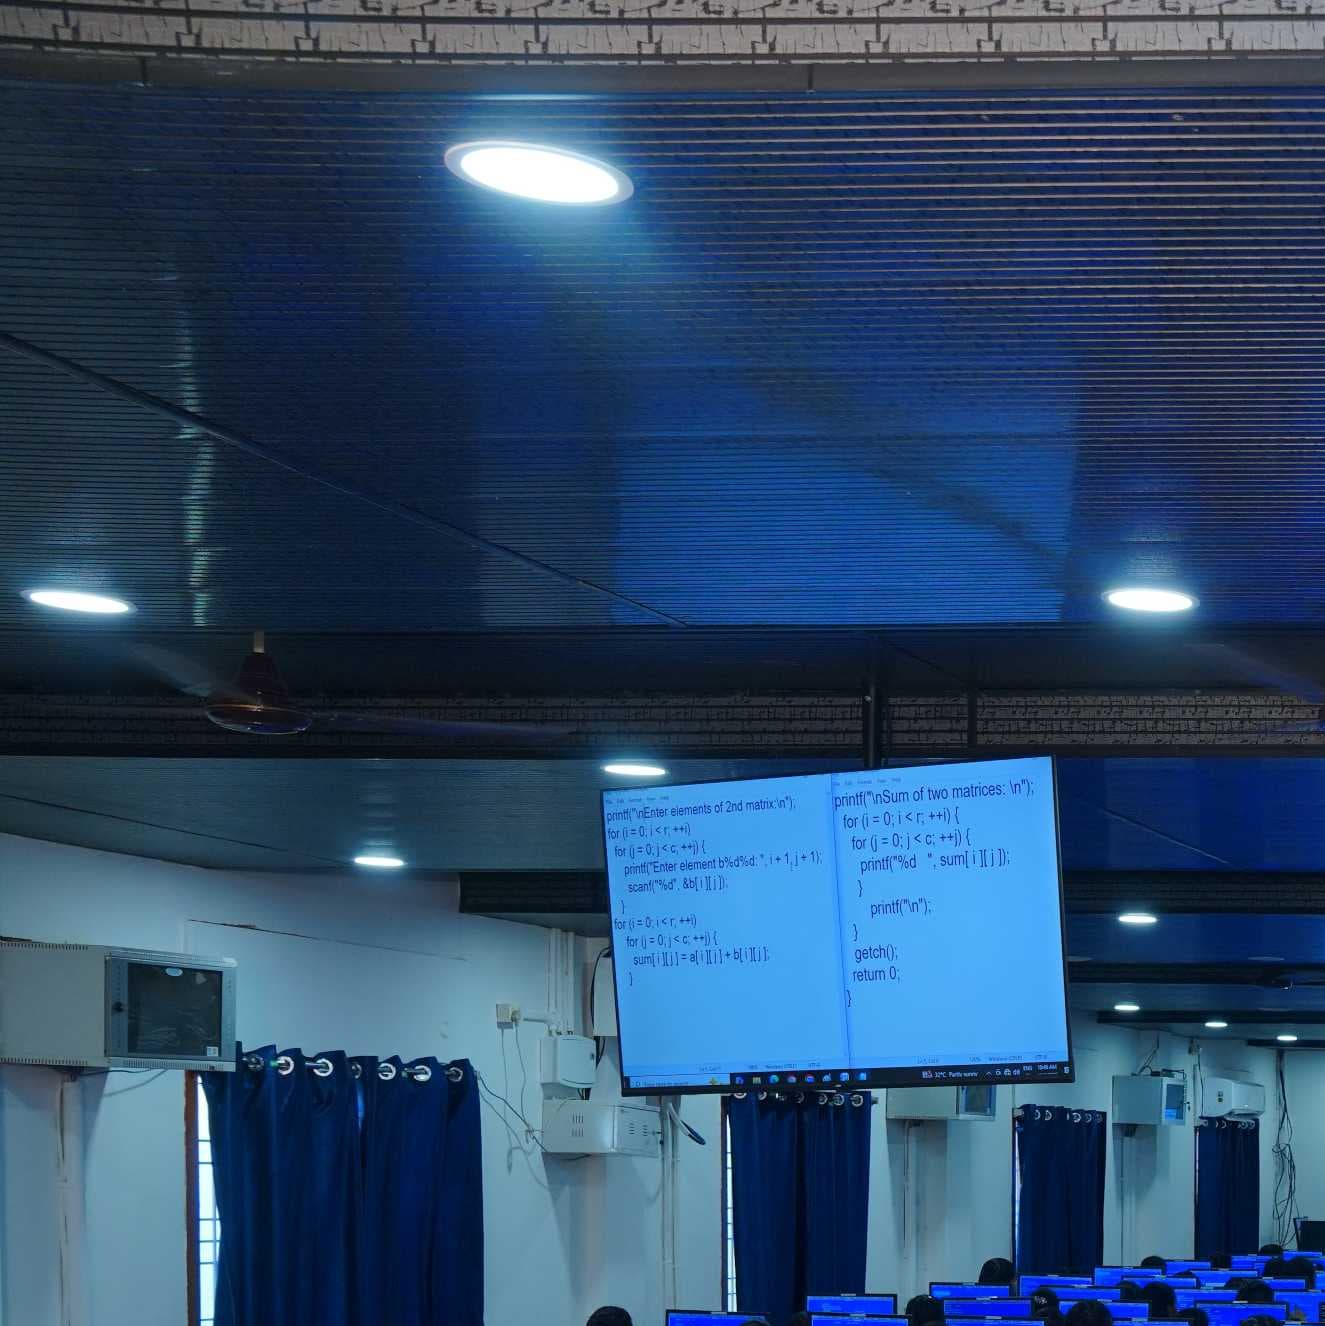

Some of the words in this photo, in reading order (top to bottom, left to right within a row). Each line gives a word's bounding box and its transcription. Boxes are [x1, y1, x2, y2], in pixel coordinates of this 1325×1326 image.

[913, 787, 925, 801] of
[927, 787, 949, 800] two
[952, 782, 1005, 798] matrices:
[670, 802, 711, 816] elements
[714, 801, 724, 814] of
[725, 800, 742, 813] 2nd
[680, 858, 716, 871] element
[855, 944, 897, 962] getch();
[853, 968, 885, 982] return
[889, 966, 899, 981] 0;
